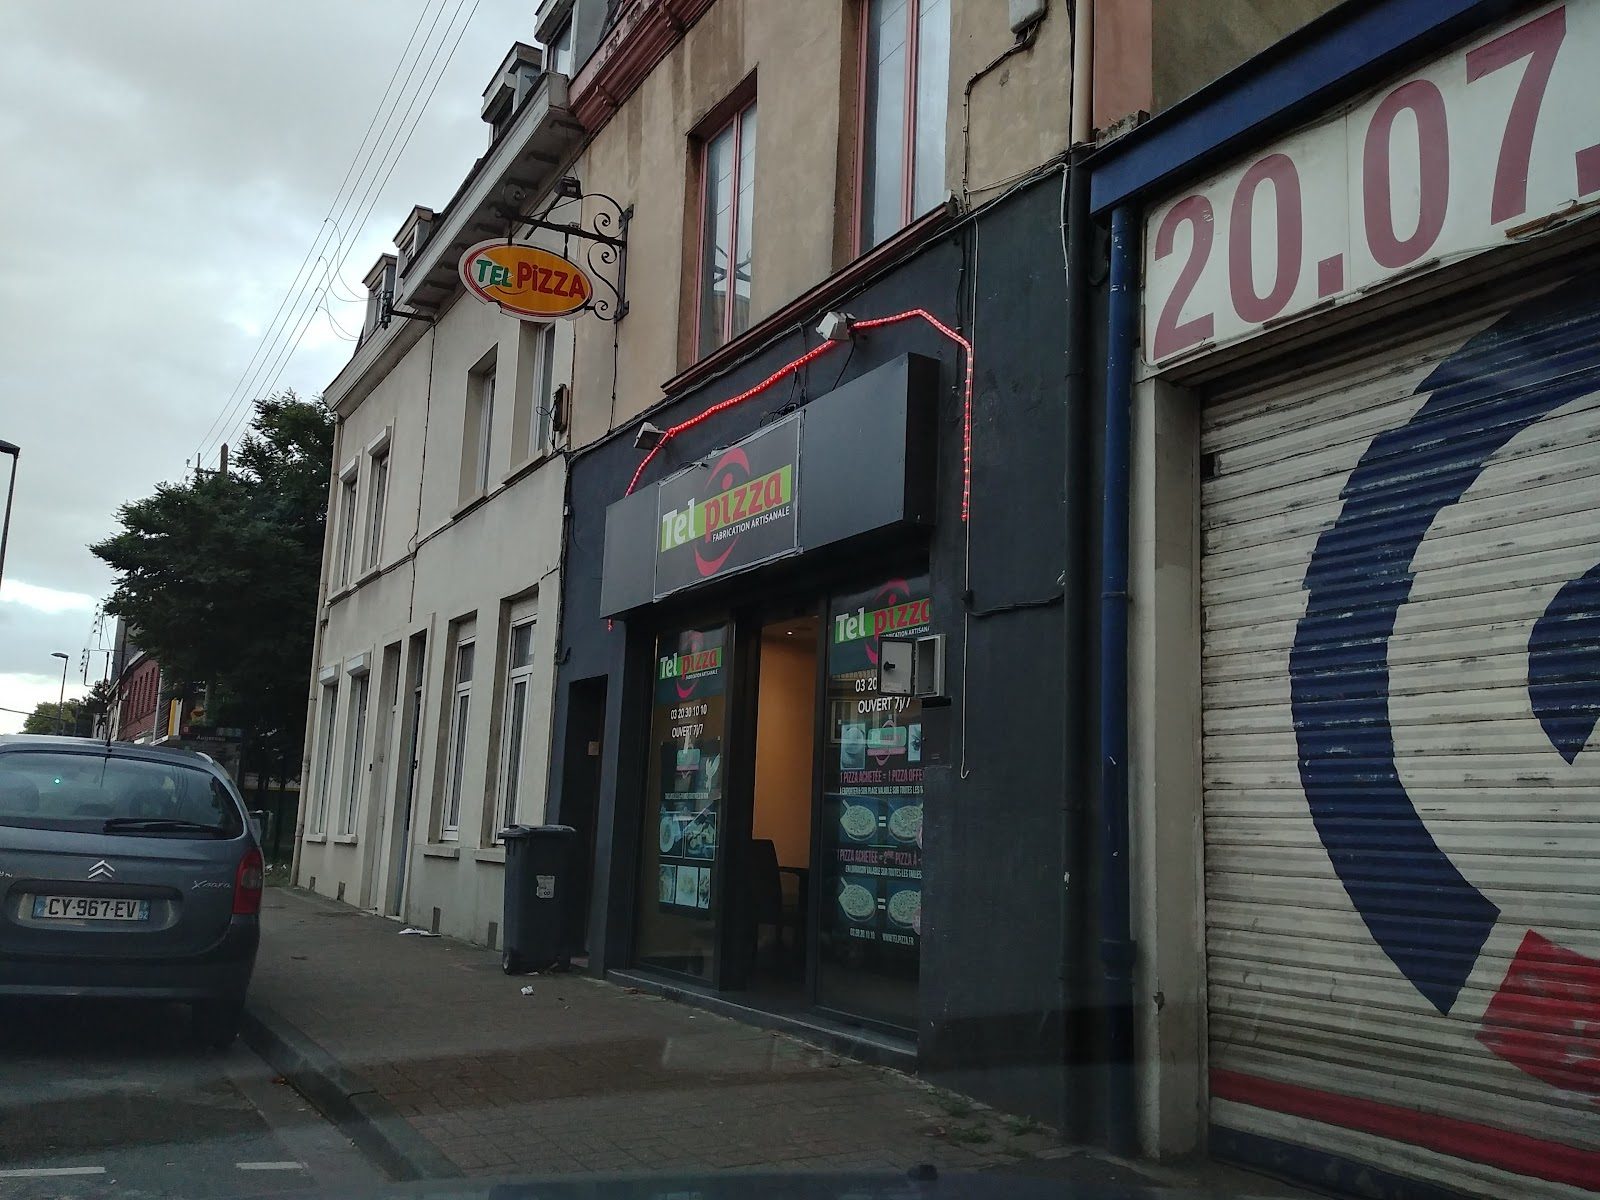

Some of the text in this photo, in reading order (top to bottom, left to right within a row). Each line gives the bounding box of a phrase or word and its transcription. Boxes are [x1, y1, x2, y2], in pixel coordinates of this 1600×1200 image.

[476, 259, 512, 287] TEL
[663, 472, 783, 550] Tel pizza
[712, 506, 790, 542] FABRICATION ARTISANALE
[836, 607, 866, 641] Tel
[660, 645, 717, 680] Tel pizza
[855, 677, 878, 692] 03 20
[671, 709, 678, 720] 03
[678, 708, 685, 719] 20
[685, 707, 692, 717] 30
[693, 706, 700, 716] 10
[858, 697, 893, 713] OUVERT
[672, 725, 693, 738] OUVERT
[843, 771, 859, 784] PIZZA
[859, 768, 882, 783] ACHETÉE
[892, 769, 908, 782] PIZZA
[908, 768, 924, 781] OFFE
[48, 898, 137, 918] CY-967-EV
